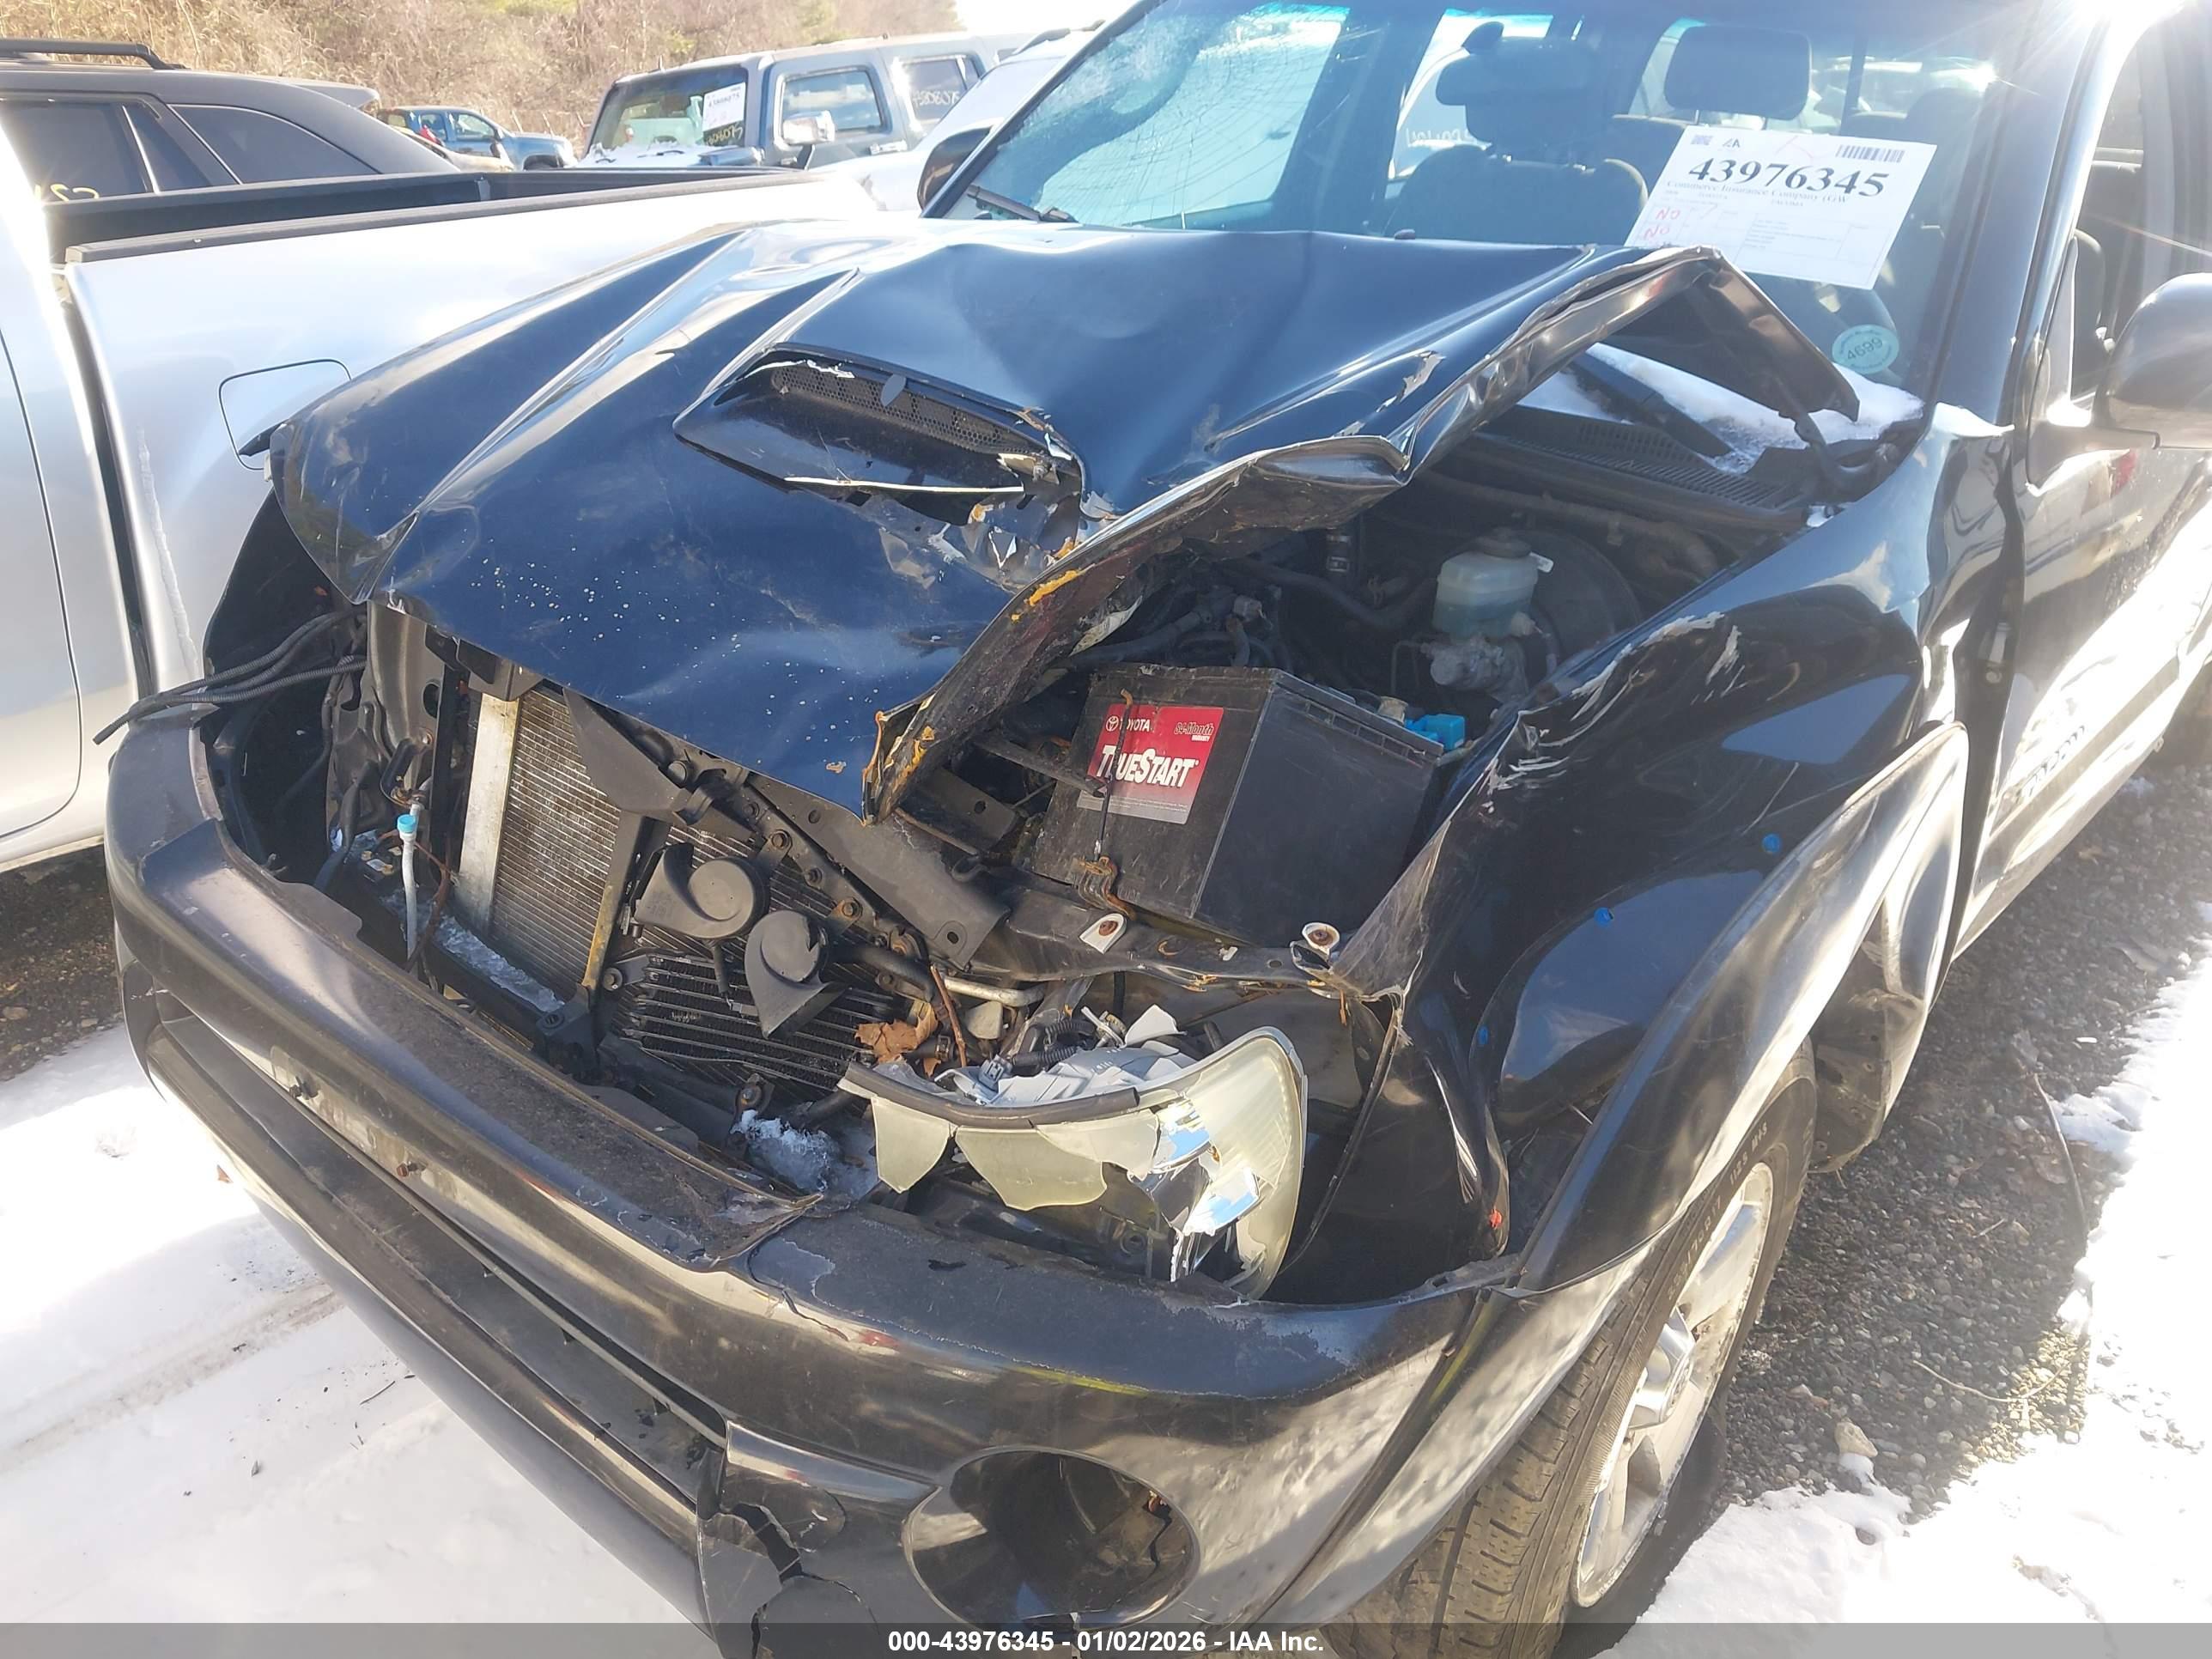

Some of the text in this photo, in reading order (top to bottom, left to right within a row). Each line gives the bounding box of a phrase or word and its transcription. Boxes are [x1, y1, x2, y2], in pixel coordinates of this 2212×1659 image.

[1667, 181, 1717, 191] Commerce
[1721, 185, 1765, 196] Insurance
[1771, 190, 1818, 200] Company
[1689, 158, 1889, 197] 43976345
